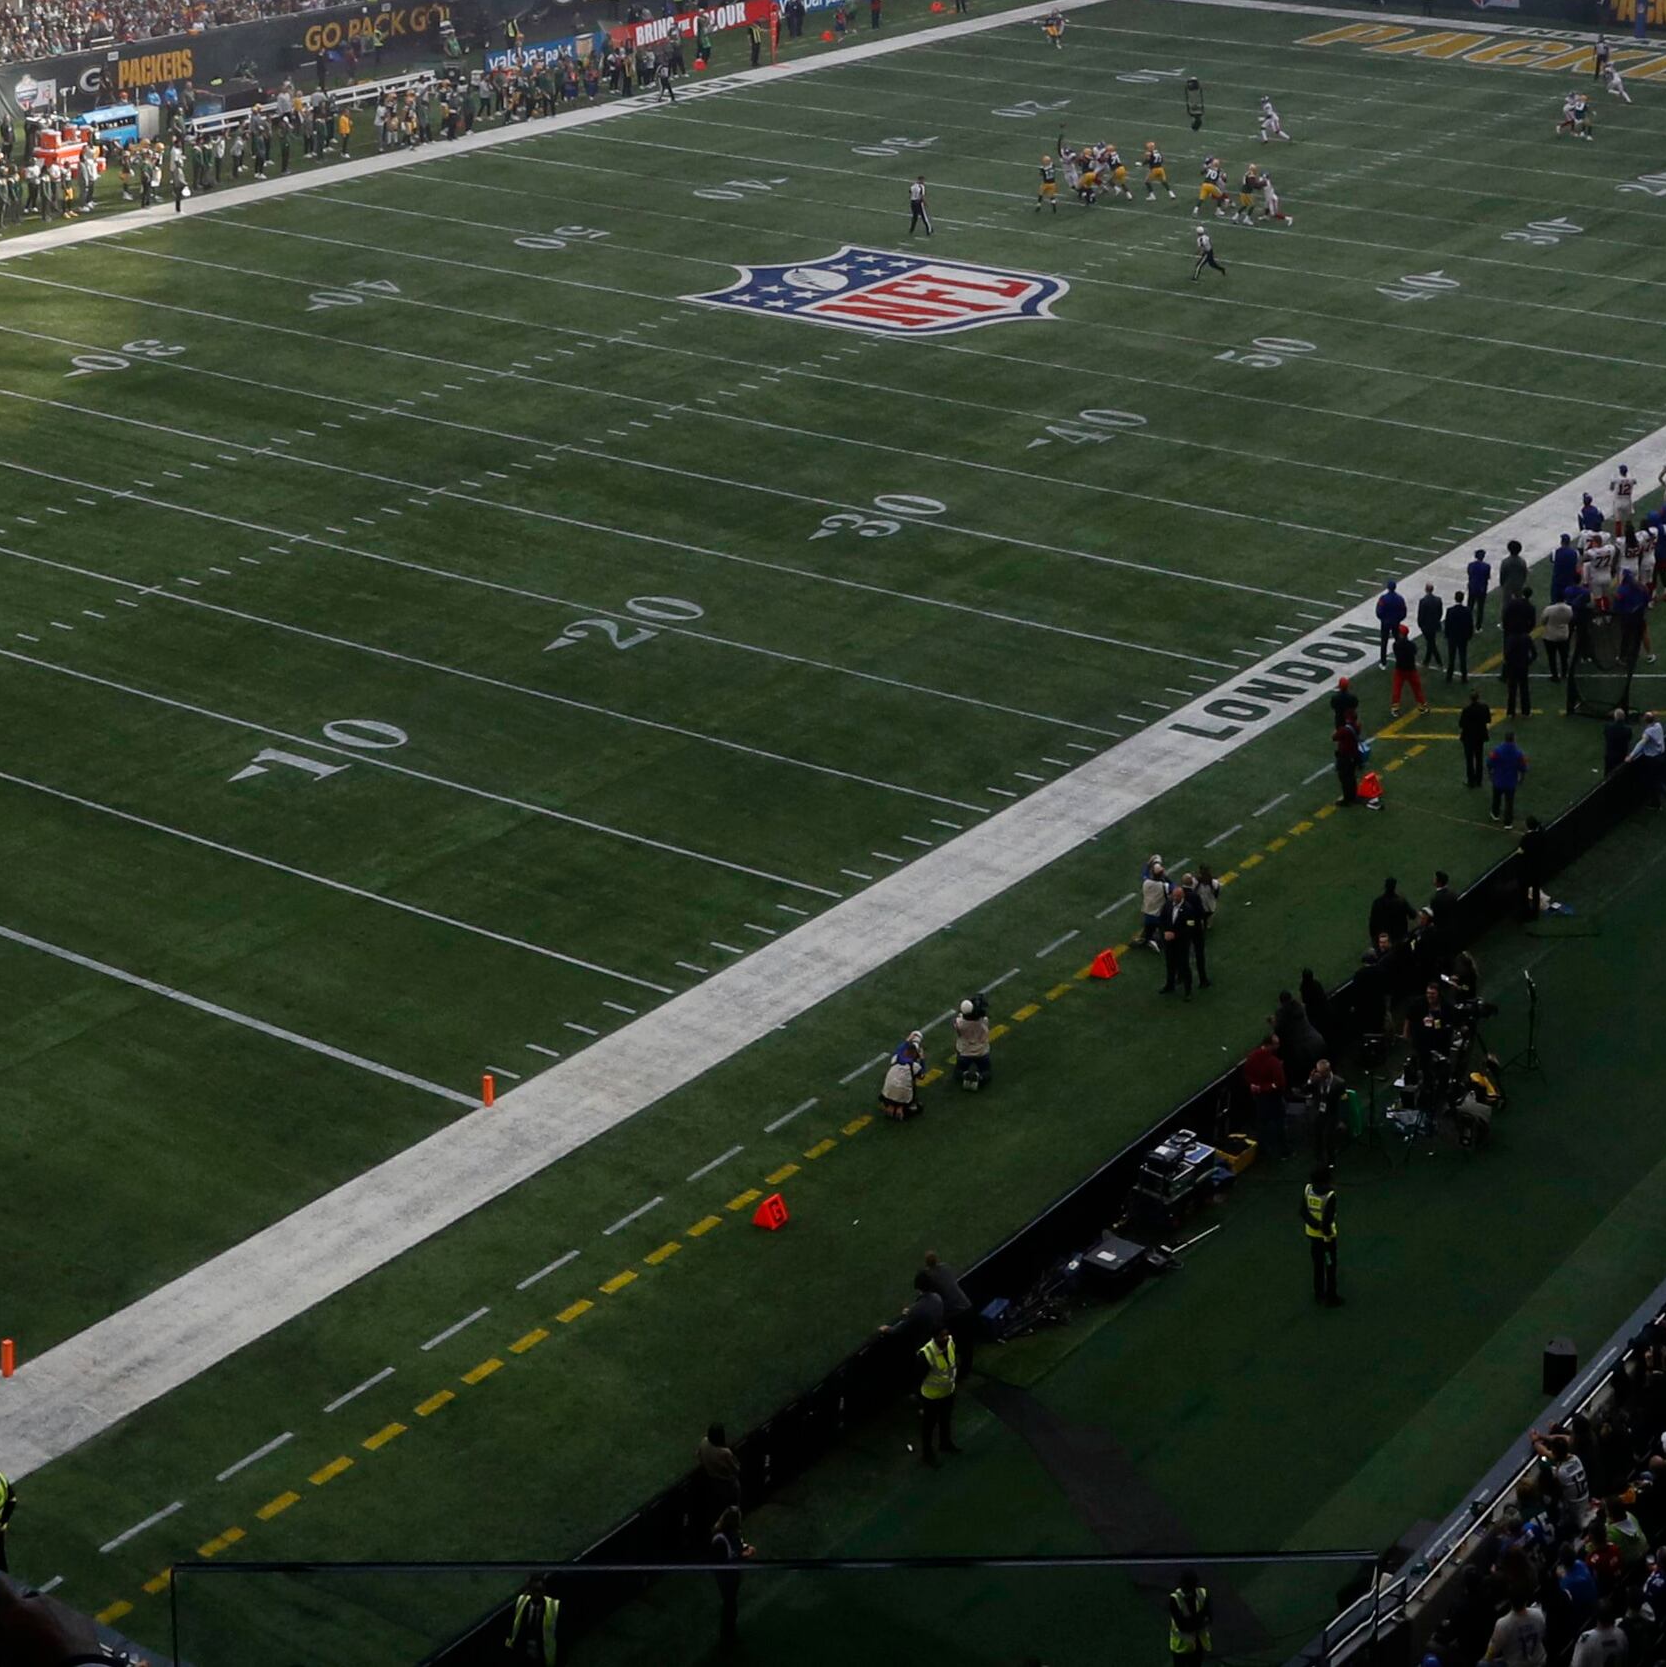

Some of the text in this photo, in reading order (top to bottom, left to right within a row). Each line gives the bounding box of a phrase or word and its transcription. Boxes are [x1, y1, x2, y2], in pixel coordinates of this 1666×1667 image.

[304, 21, 342, 52] GO
[117, 48, 193, 89] PACKERS
[991, 99, 1063, 118] 20
[850, 136, 933, 157] 30
[692, 178, 774, 201] 40
[513, 224, 610, 250] 50
[1501, 221, 1584, 247] 30
[307, 278, 402, 310] 40
[812, 272, 1036, 328] NFL
[1375, 274, 1461, 302] 40
[71, 339, 187, 373] 30
[1214, 337, 1318, 368] 50
[1045, 409, 1148, 444] 40
[1617, 483, 1632, 496] 12
[839, 493, 948, 538] 30
[1595, 554, 1611, 569] 77
[562, 594, 705, 650] 20
[1168, 622, 1383, 742] LONDON
[262, 718, 409, 783] 10
